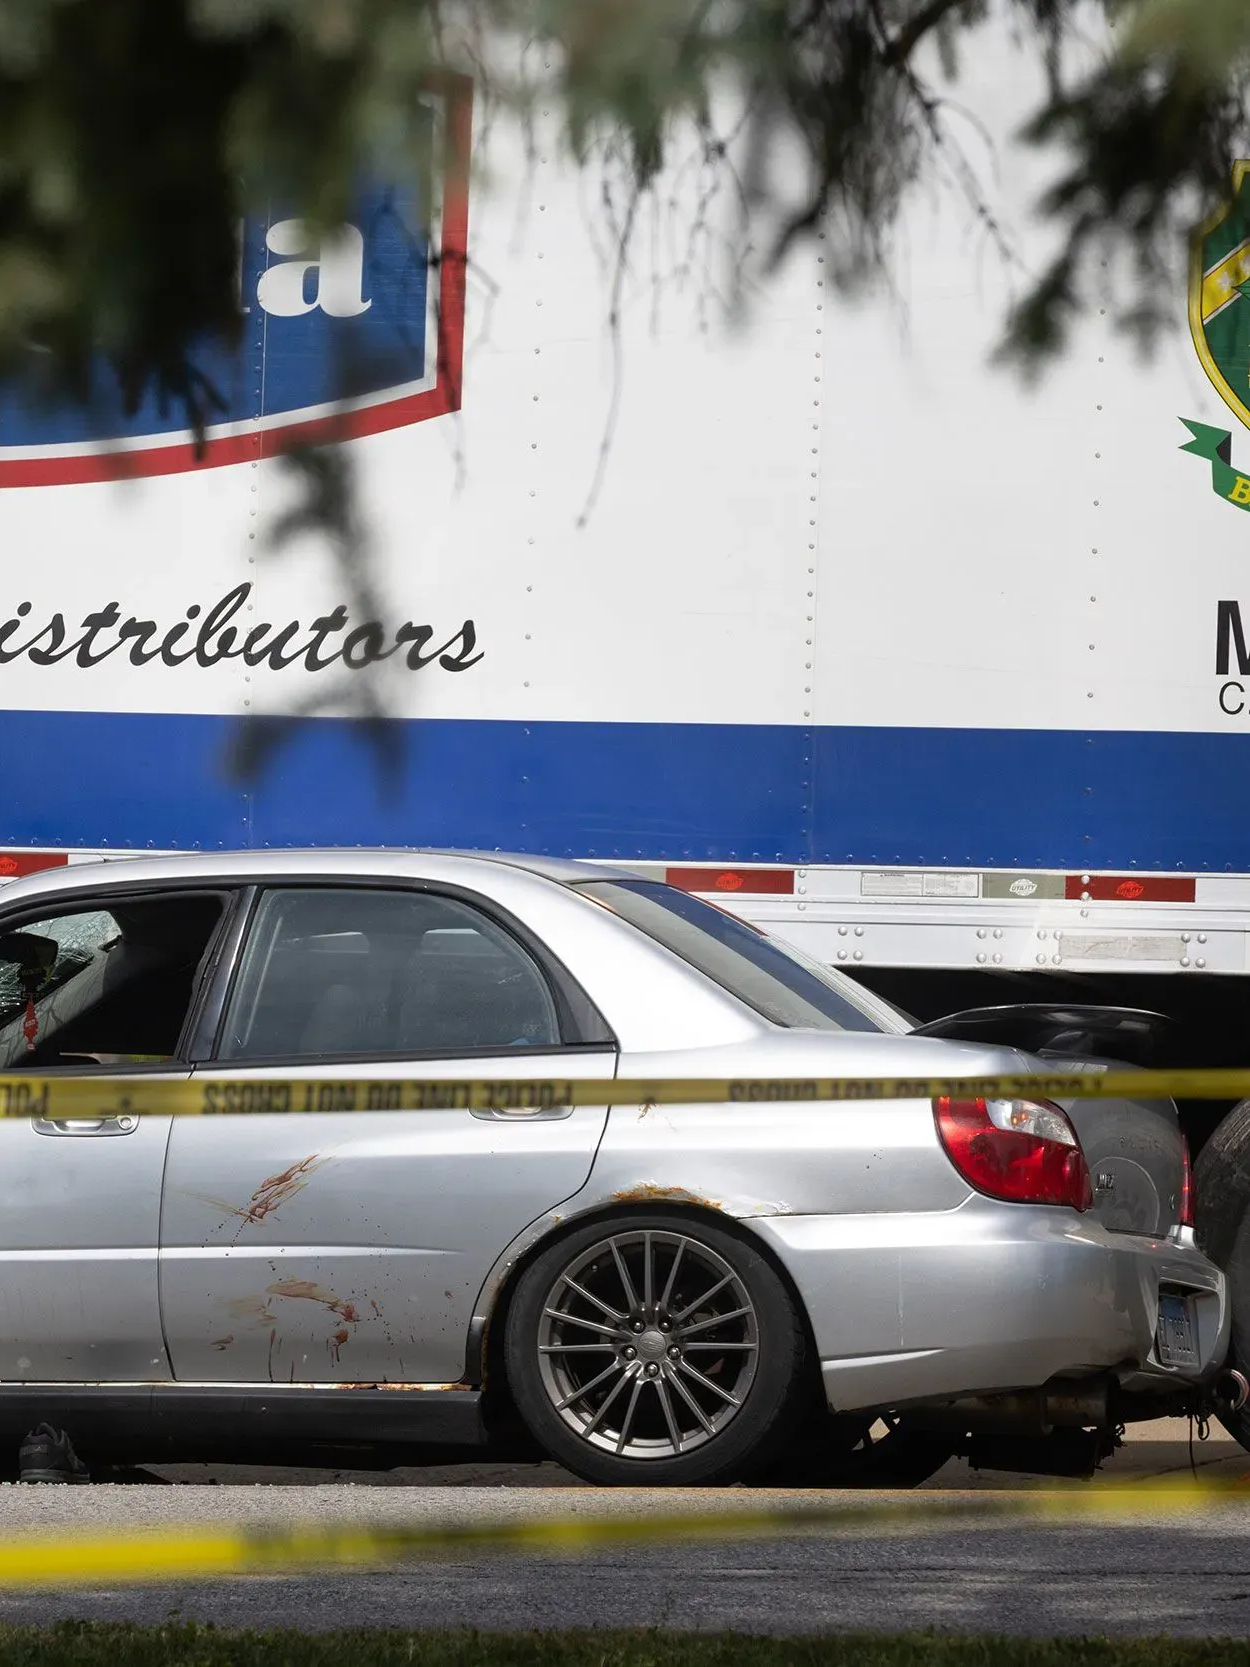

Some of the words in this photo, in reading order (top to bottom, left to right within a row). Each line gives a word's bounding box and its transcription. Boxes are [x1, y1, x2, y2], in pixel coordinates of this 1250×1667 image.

[1219, 681, 1250, 715] C
[202, 1084, 290, 1114] CROSS
[303, 1083, 355, 1112] NOT
[366, 1083, 402, 1111] DO
[415, 1082, 474, 1109] LINE
[483, 1081, 573, 1107] POLICE
